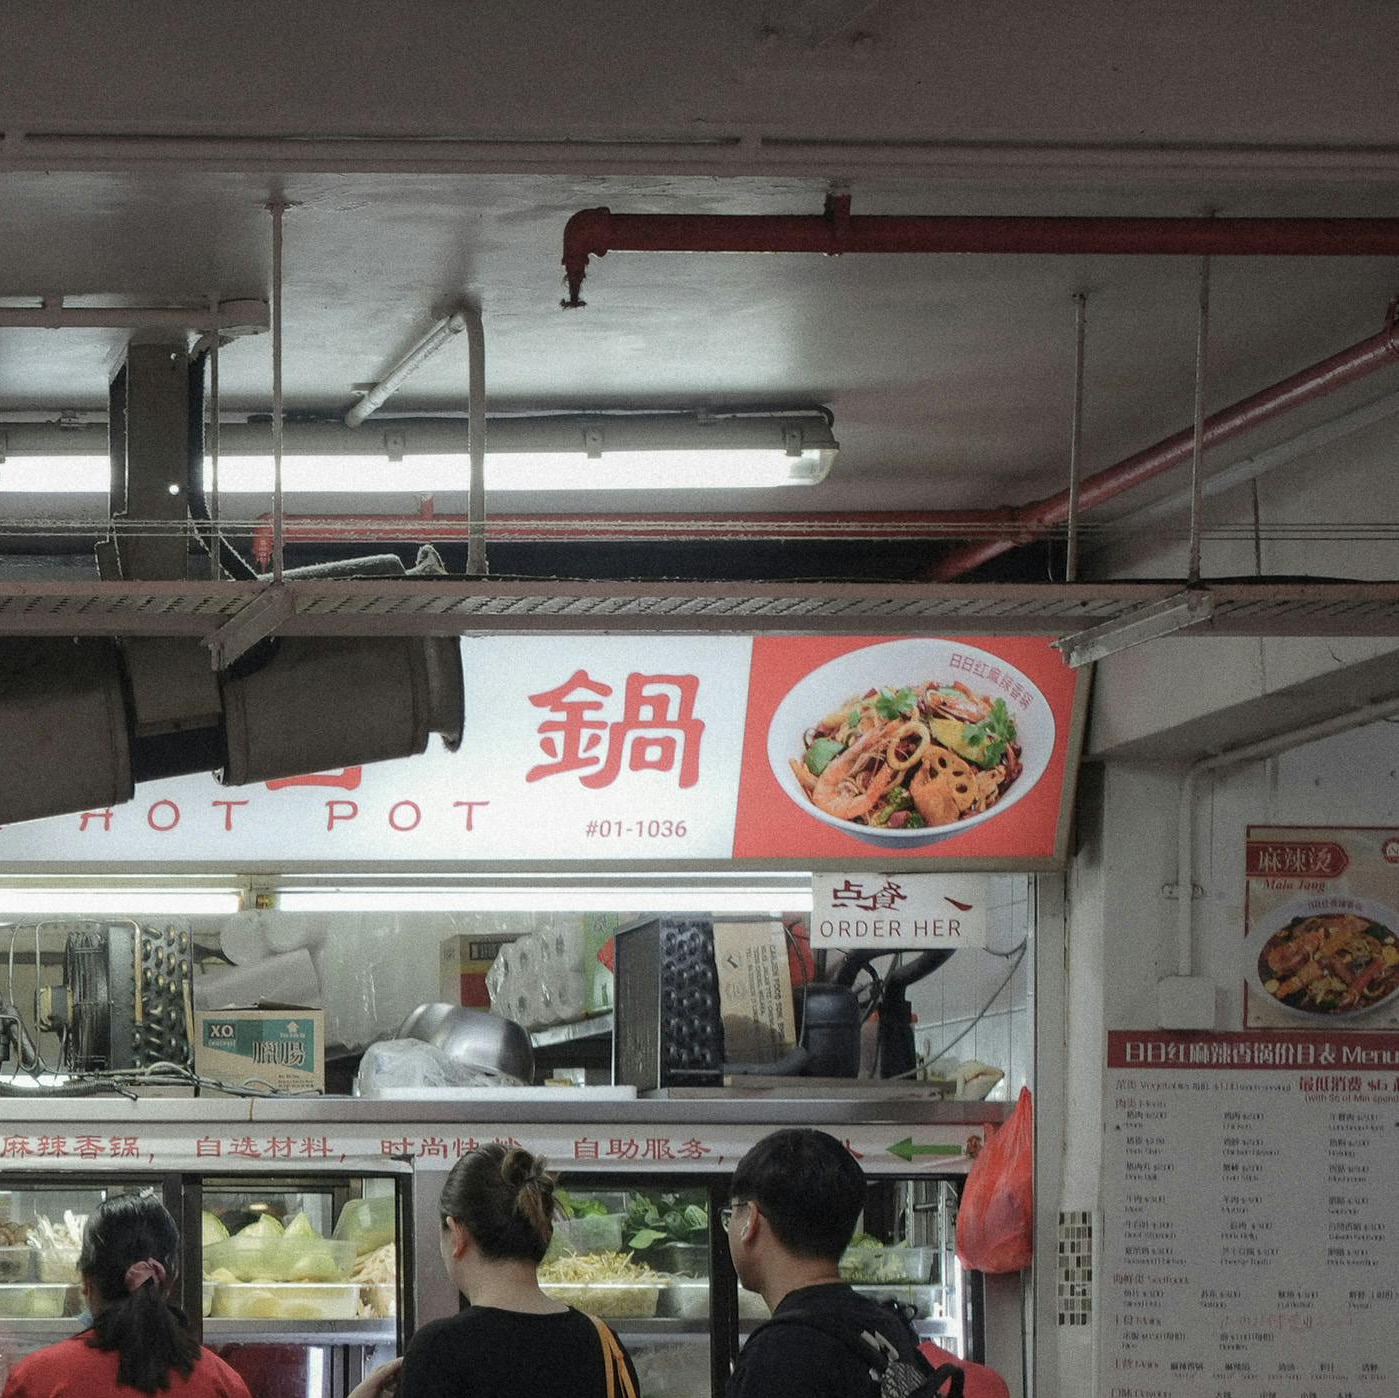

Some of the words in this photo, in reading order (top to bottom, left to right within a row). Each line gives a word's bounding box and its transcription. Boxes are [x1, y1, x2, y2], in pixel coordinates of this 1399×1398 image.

[325, 800, 491, 832] POT
[584, 819, 689, 839] #01-1036
[1258, 847, 1333, 874] 麻辣烫
[819, 919, 903, 938] ORDER
